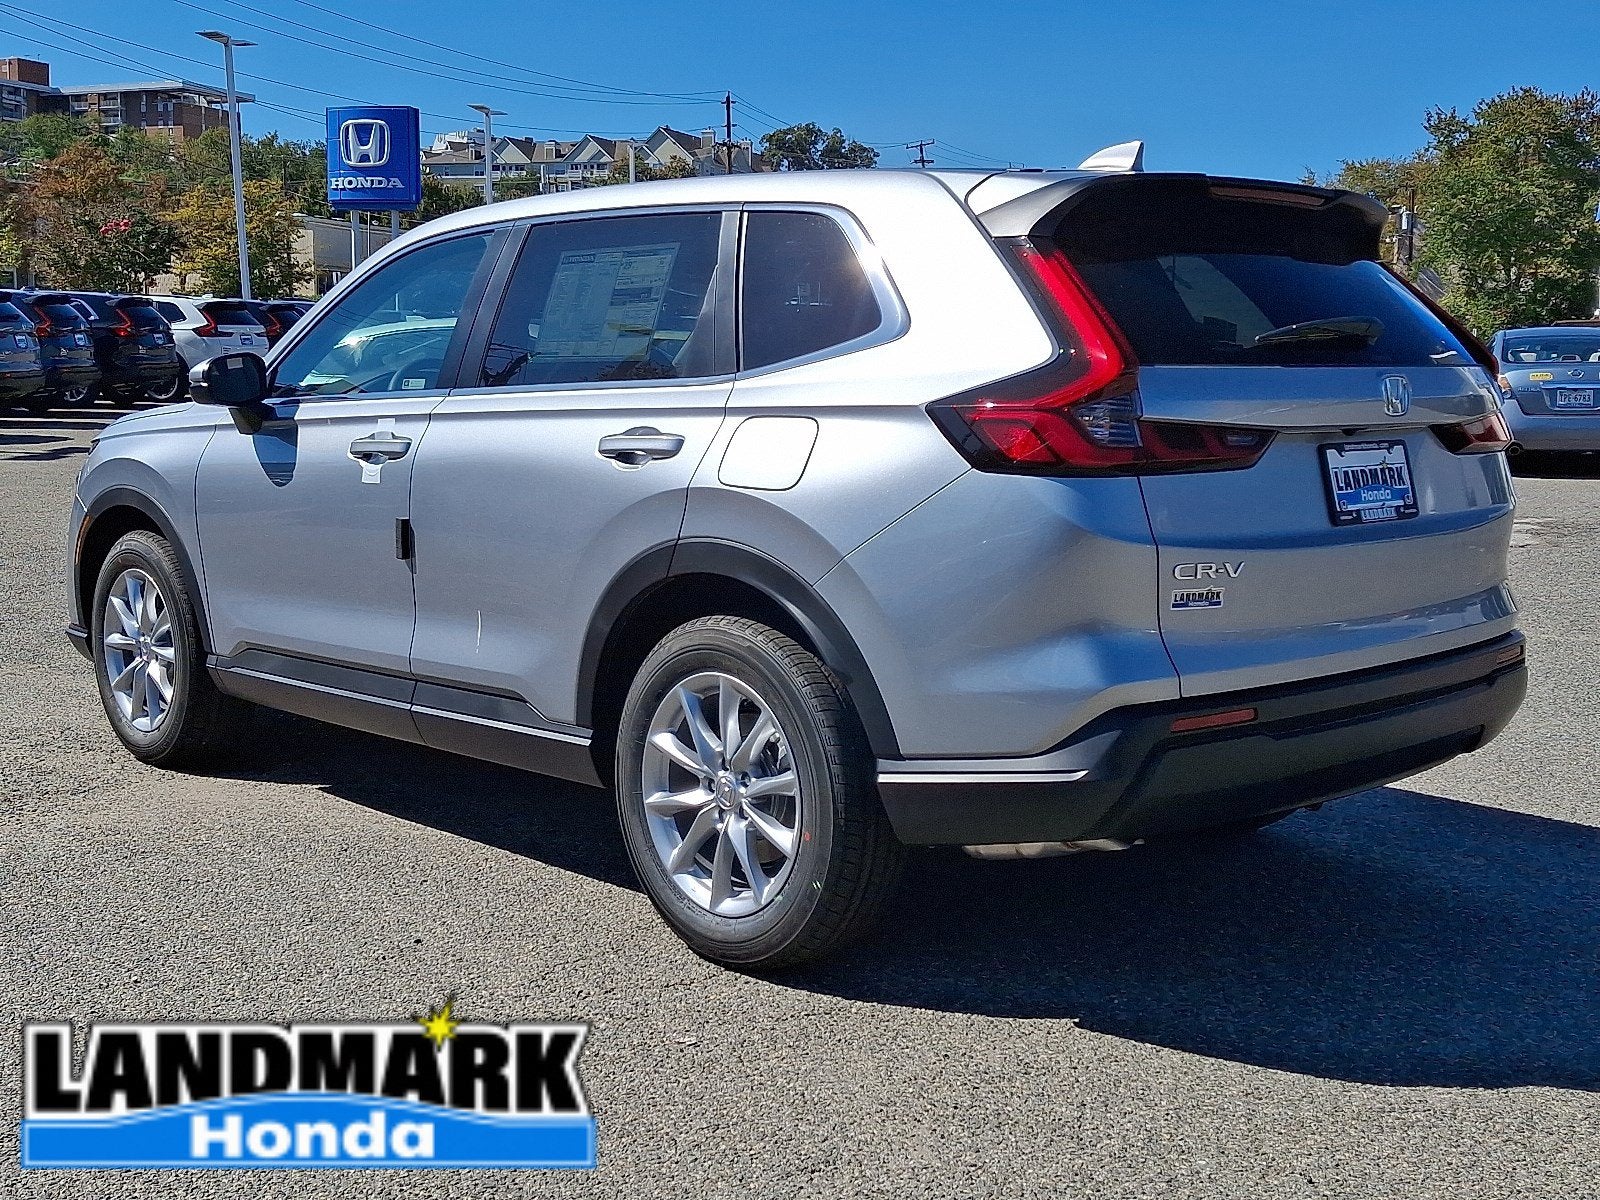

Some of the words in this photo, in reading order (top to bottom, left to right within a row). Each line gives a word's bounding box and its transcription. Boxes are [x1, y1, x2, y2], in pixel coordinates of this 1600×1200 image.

[330, 177, 405, 189] HONDA
[1333, 465, 1408, 493] LANDMARK
[1361, 488, 1391, 501] Honda
[1173, 561, 1245, 580] CR-V
[1173, 591, 1222, 603] LANDMARK
